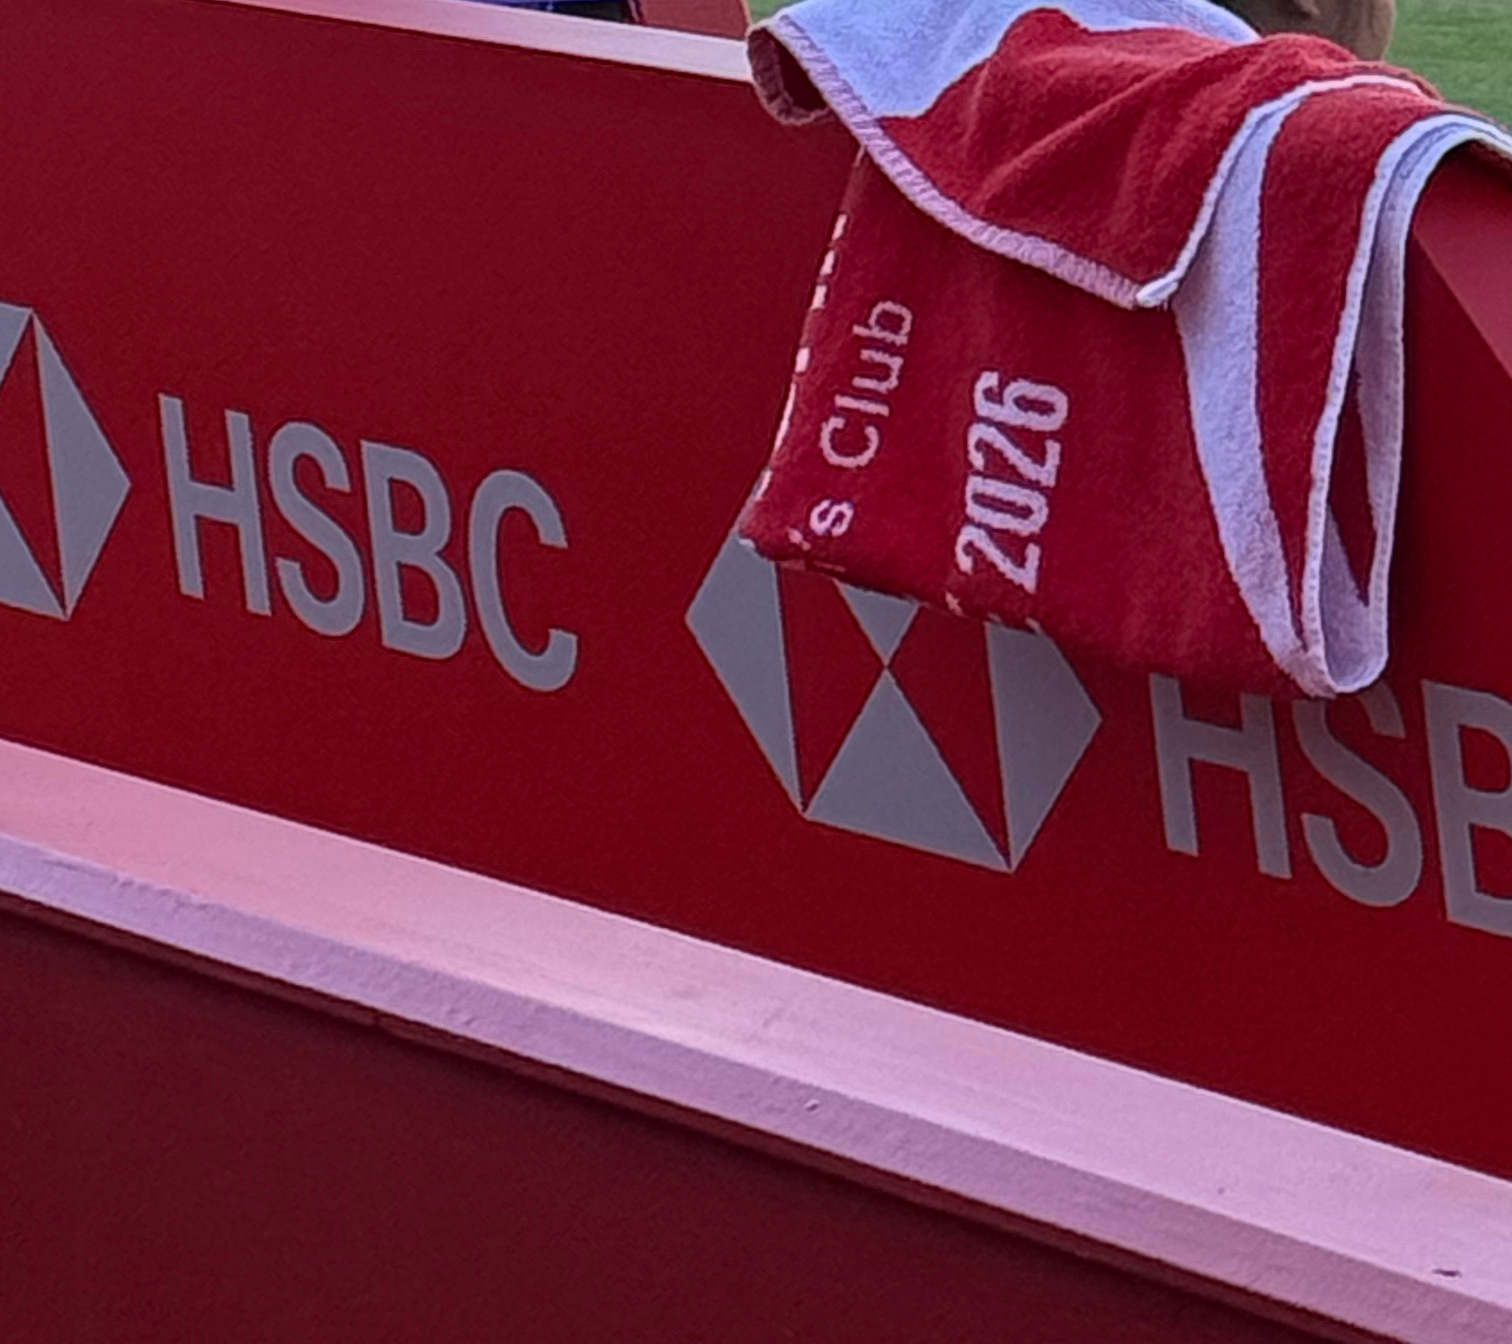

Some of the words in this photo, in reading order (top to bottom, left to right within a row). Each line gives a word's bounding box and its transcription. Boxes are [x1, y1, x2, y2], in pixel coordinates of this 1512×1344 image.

[820, 300, 915, 470] Club
[955, 370, 1070, 595] 2026
[158, 392, 578, 692] HSBC
